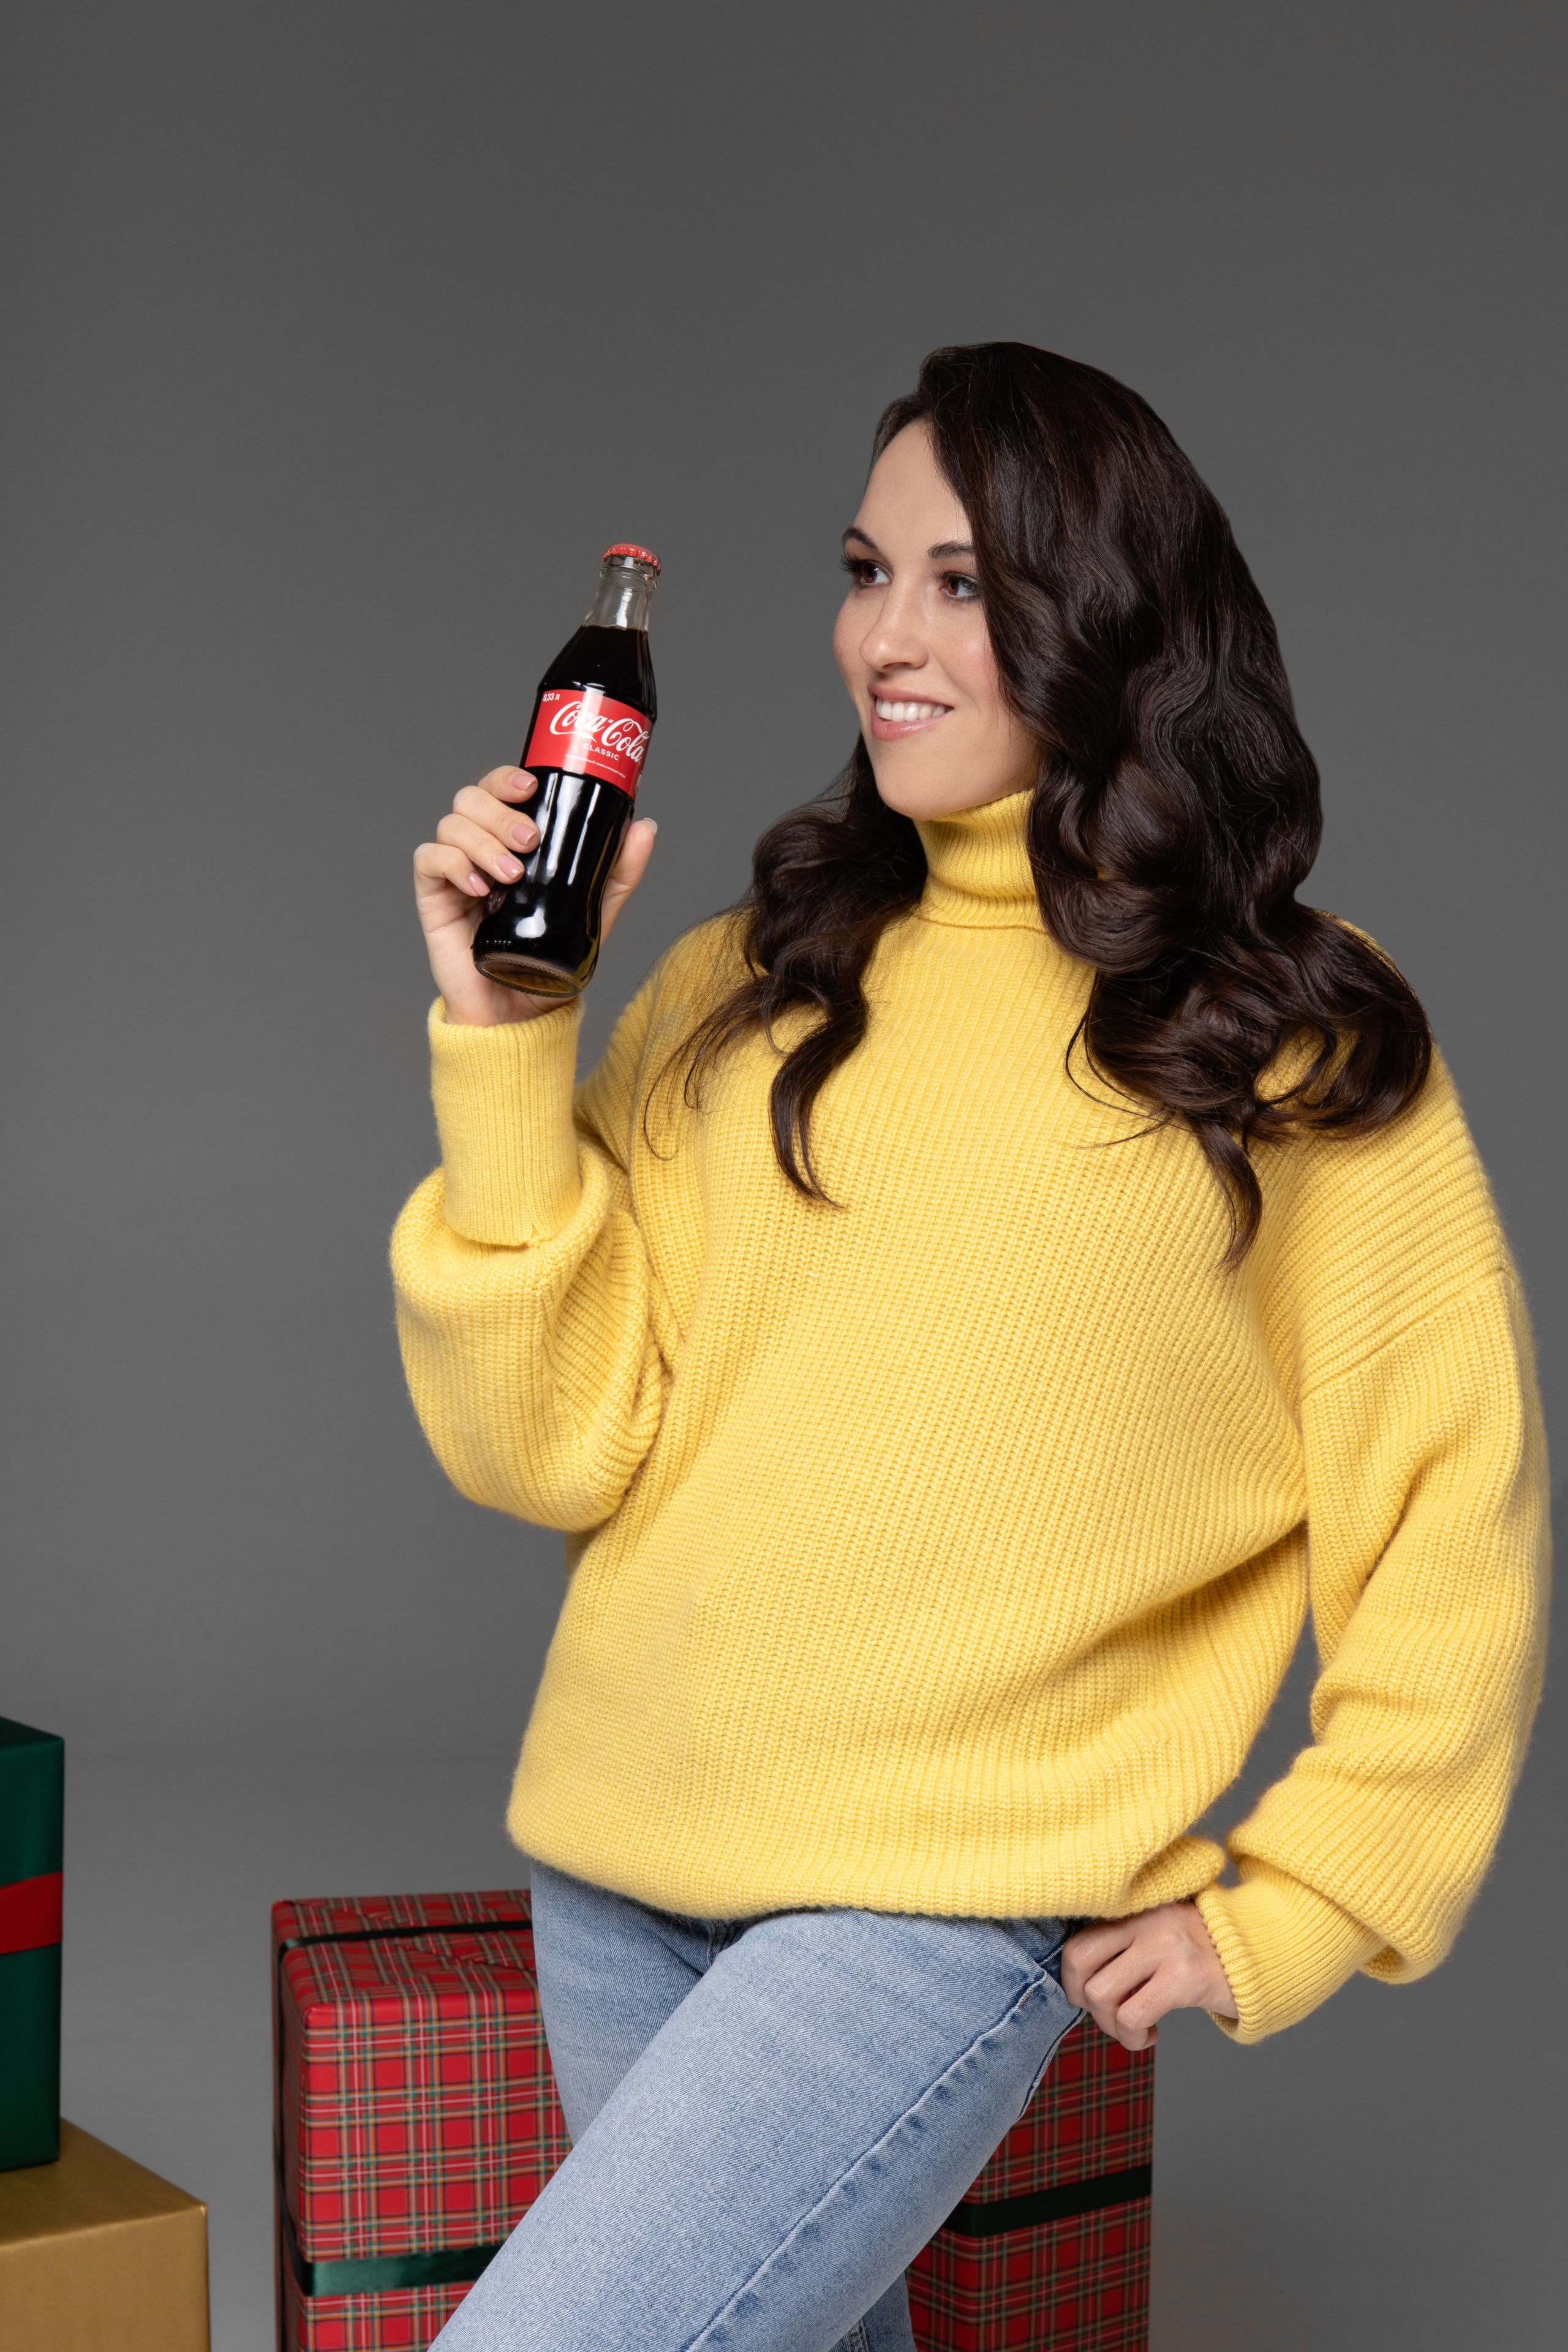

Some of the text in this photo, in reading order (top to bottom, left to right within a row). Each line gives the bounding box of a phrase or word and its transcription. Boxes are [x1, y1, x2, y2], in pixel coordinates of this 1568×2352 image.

[543, 692, 555, 703] 0,33
[549, 701, 650, 763] Coca-Cola
[583, 743, 619, 761] CLASSIC
